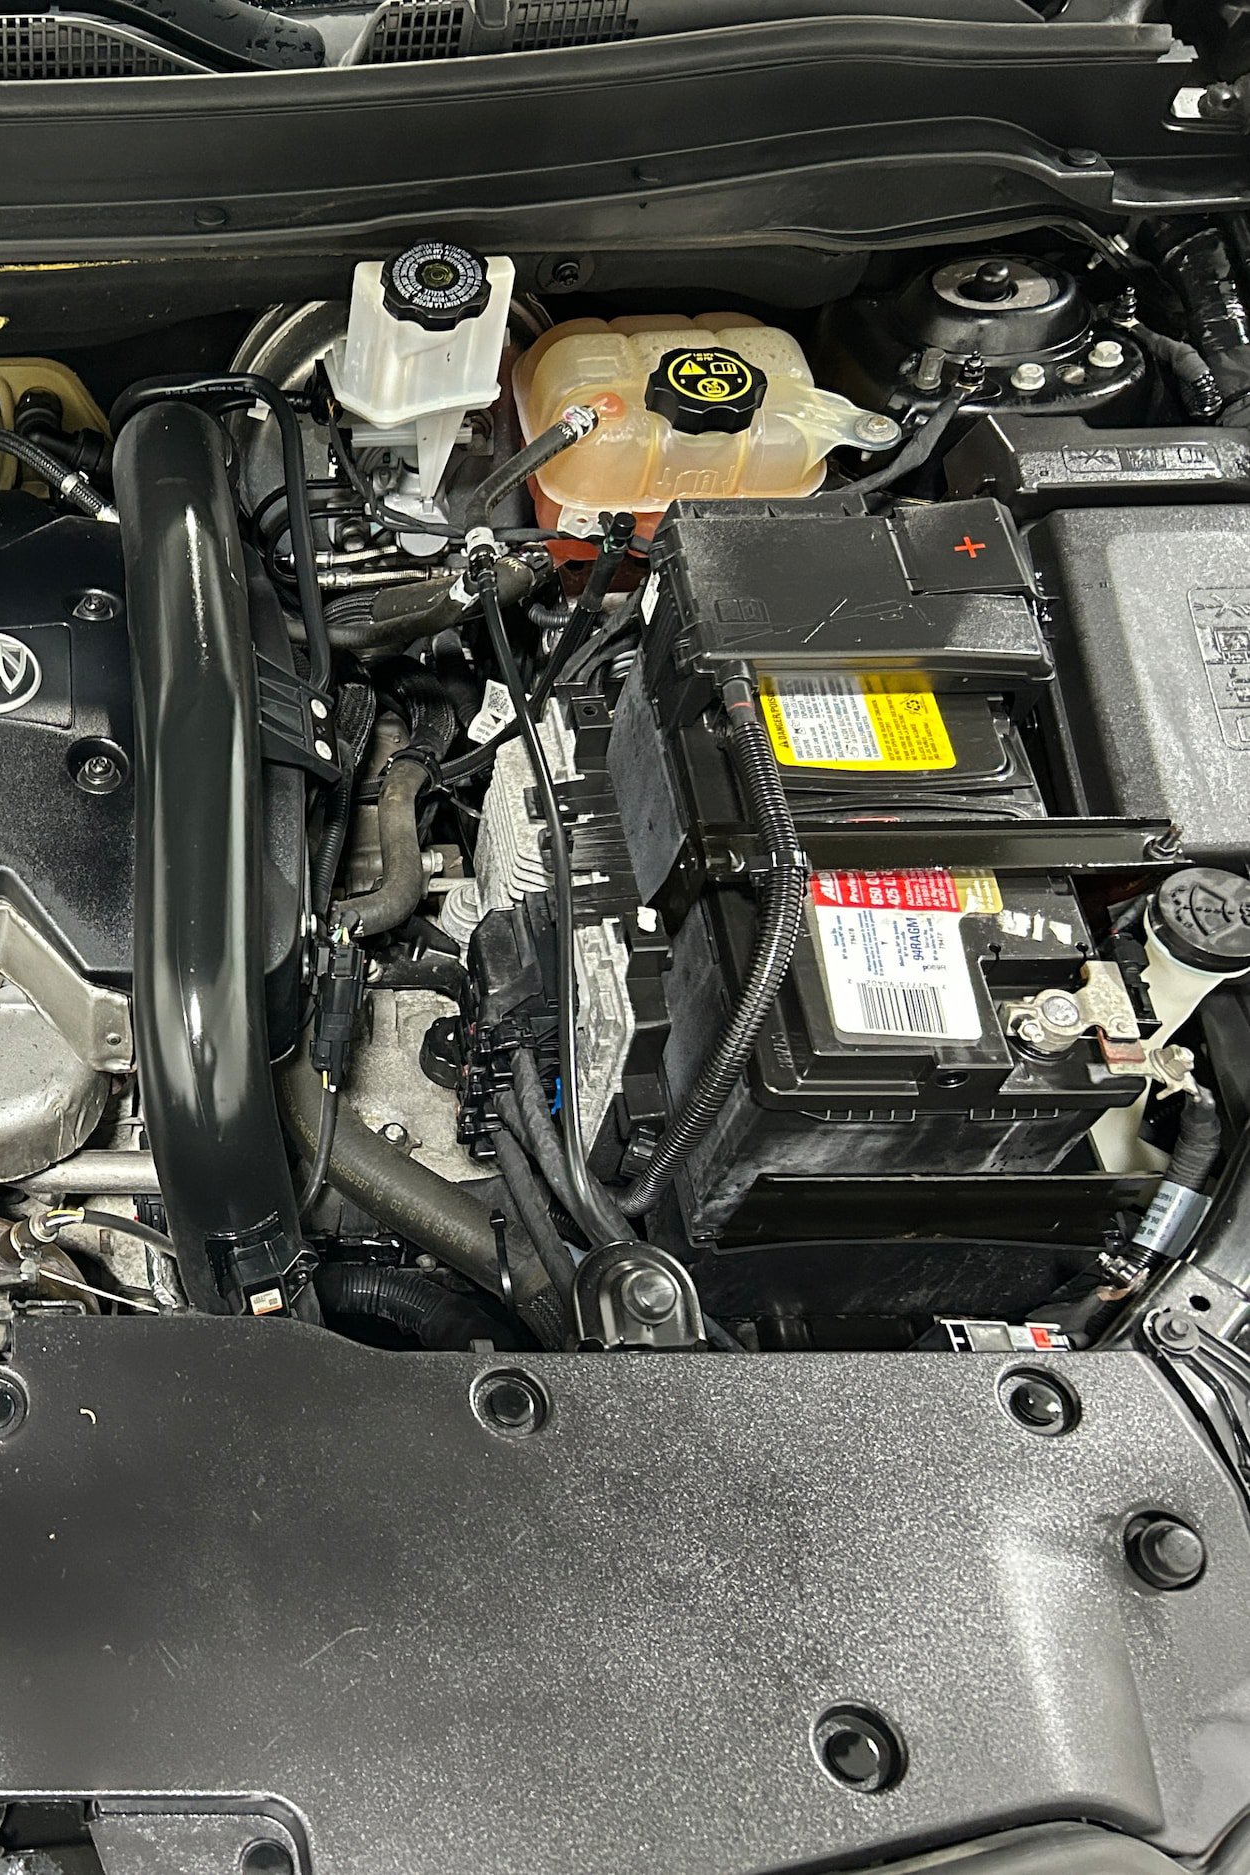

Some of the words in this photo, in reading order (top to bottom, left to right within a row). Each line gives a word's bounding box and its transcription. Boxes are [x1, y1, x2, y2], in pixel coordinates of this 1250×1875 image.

[868, 887, 884, 905] 850
[884, 887, 901, 905] 425
[905, 917, 924, 961] 94RAGM
